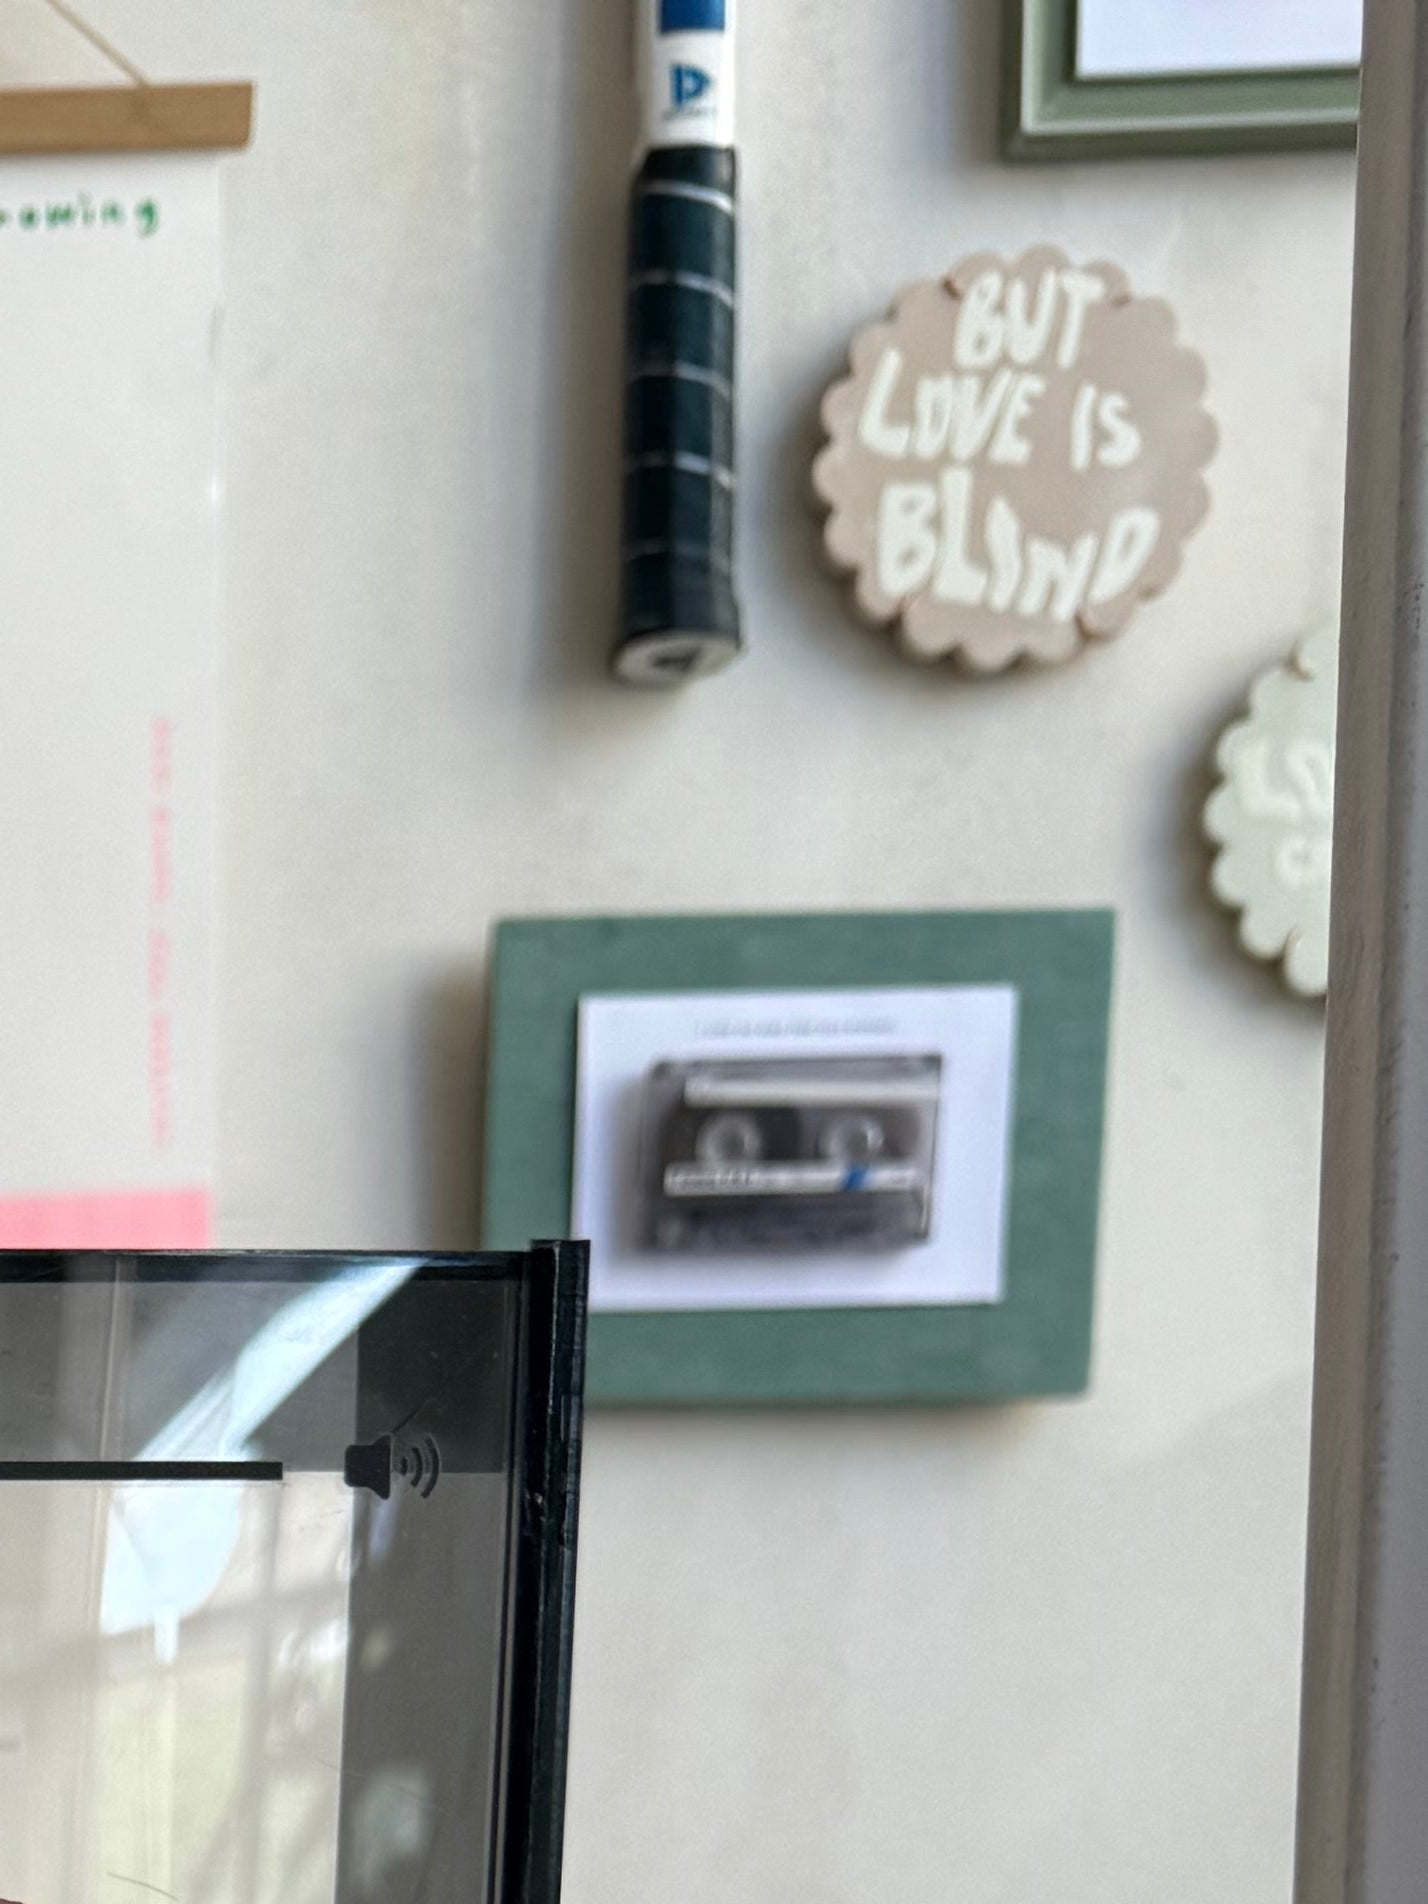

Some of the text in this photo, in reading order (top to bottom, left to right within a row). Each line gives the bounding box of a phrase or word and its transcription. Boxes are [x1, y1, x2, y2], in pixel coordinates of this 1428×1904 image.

[951, 265, 1106, 371] BUT
[857, 347, 1143, 472] LOVE IS
[876, 465, 1161, 623] BLIND
